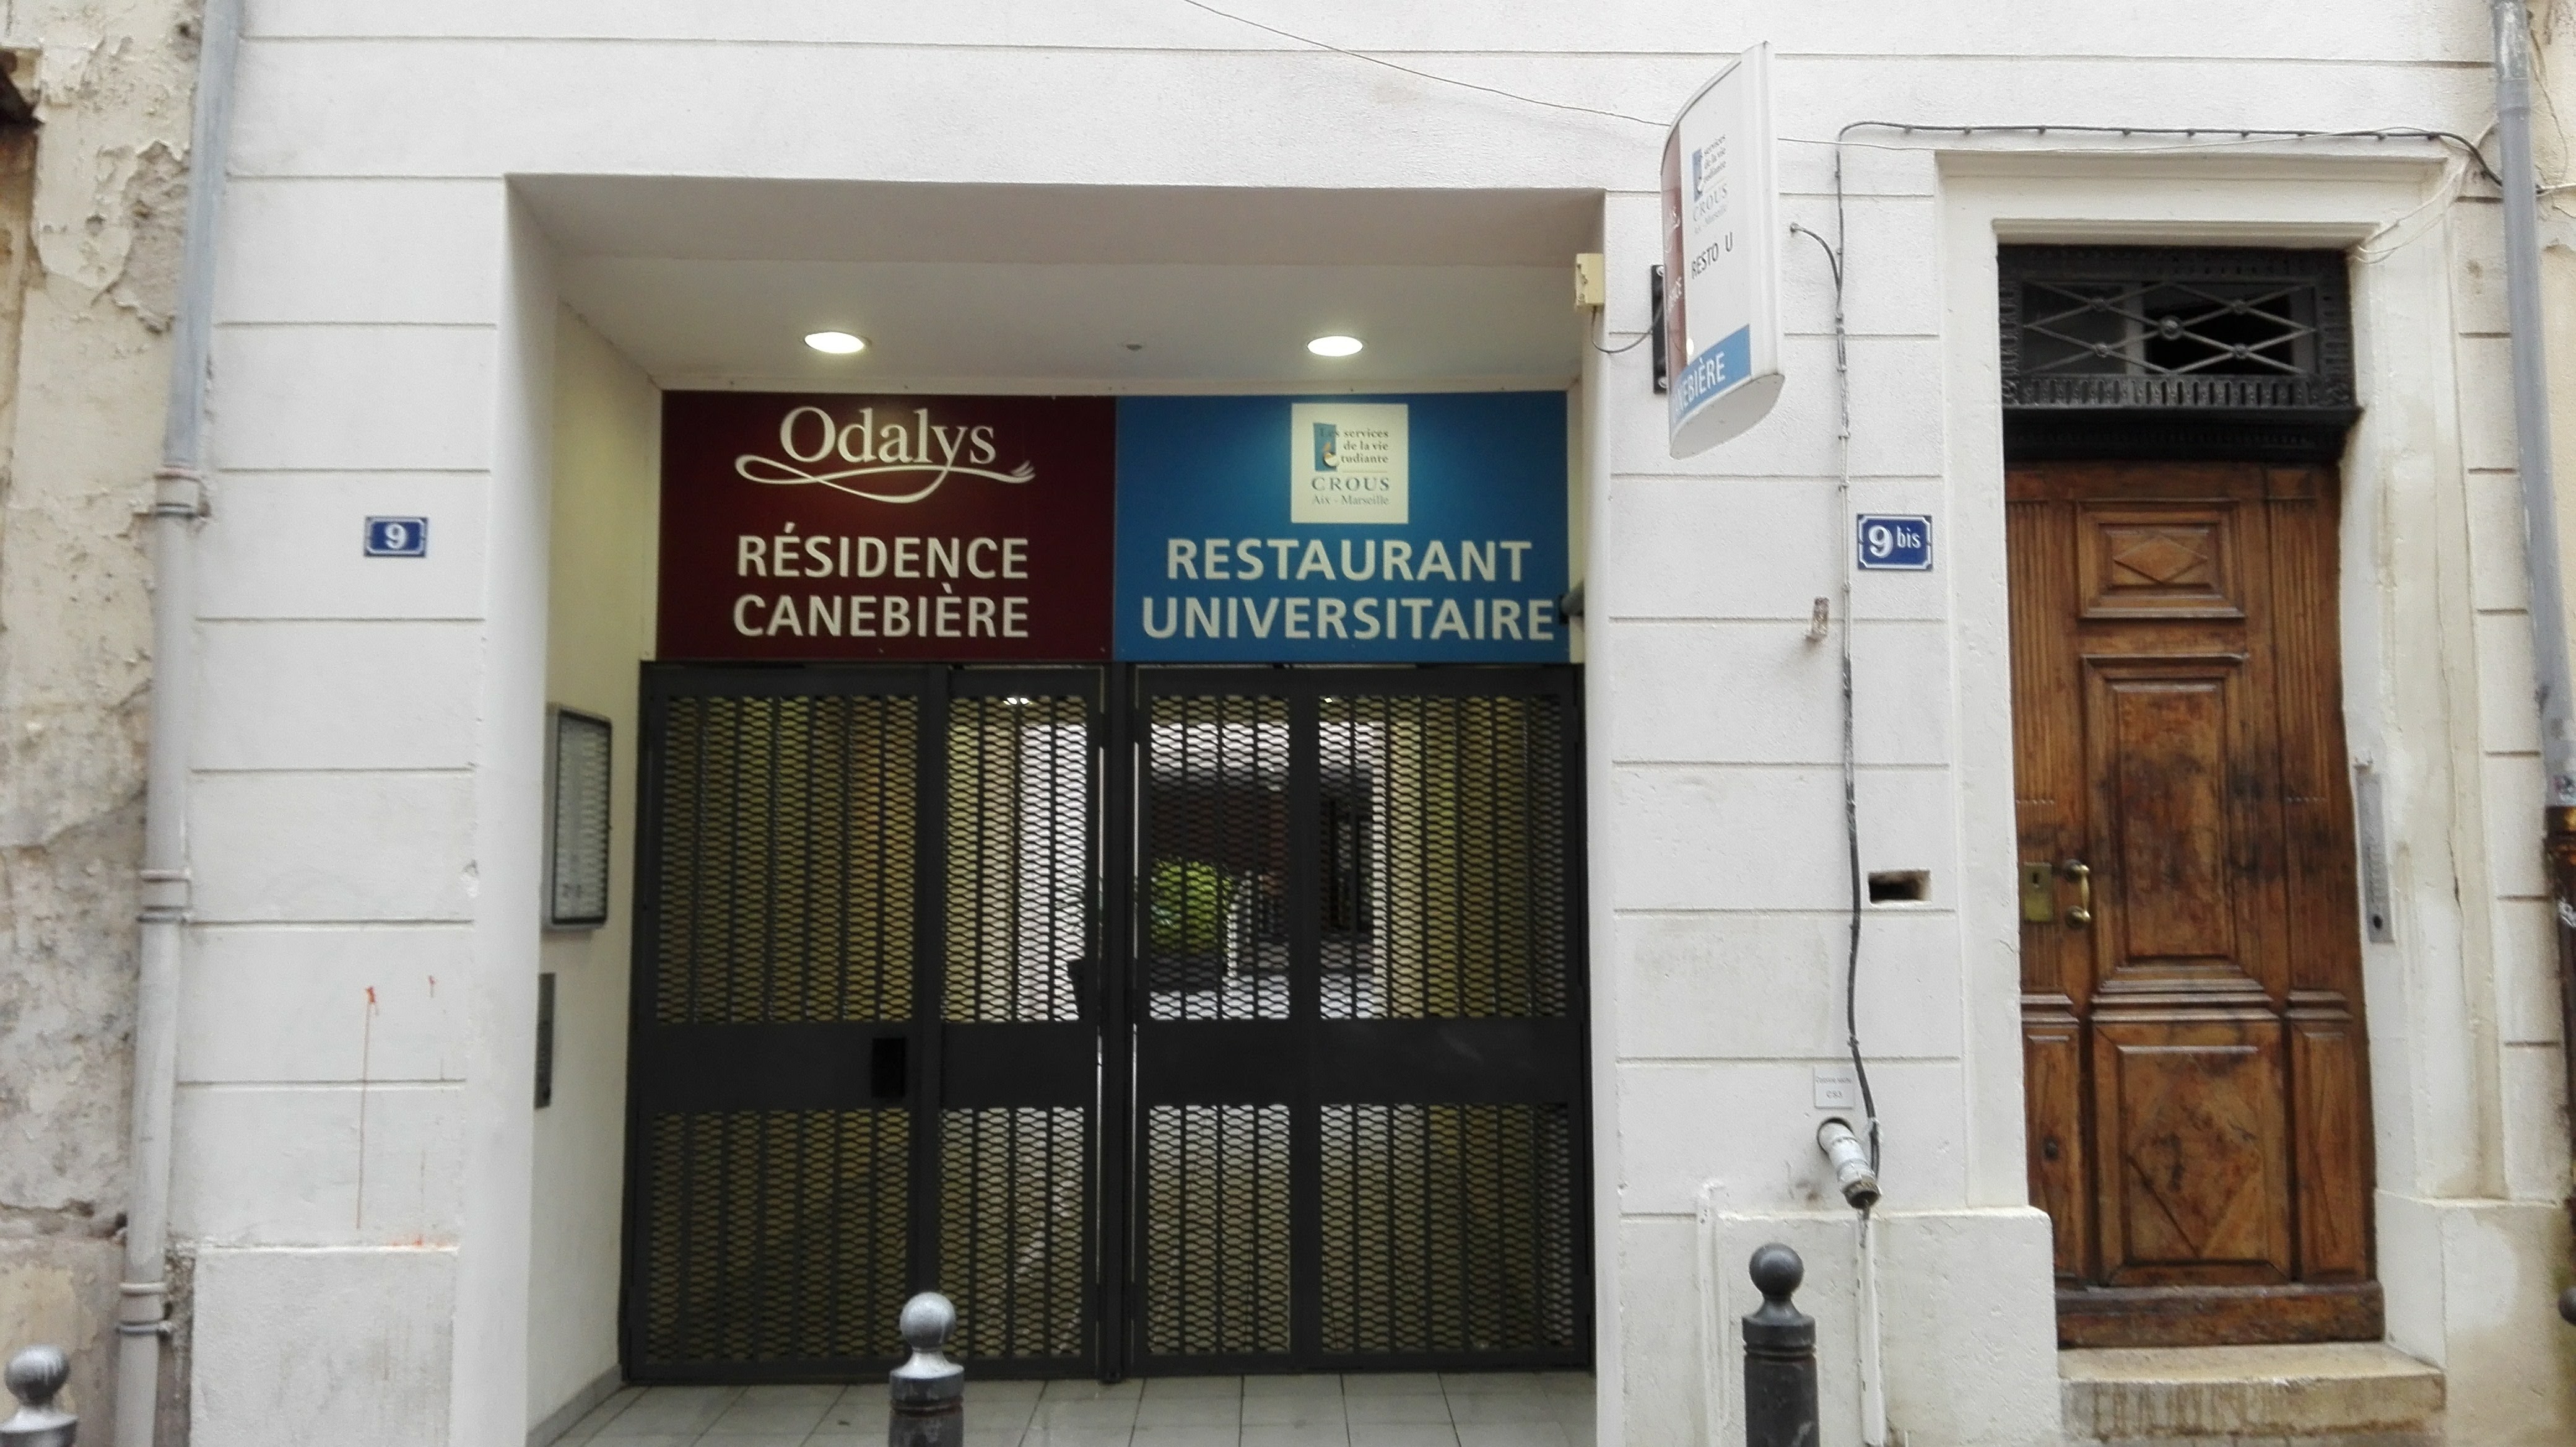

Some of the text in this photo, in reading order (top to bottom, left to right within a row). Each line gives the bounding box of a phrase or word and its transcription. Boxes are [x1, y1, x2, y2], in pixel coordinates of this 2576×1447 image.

[1691, 232, 1733, 280] RESTO U
[1343, 428, 1389, 439] services
[1343, 440, 1389, 451] de la vie
[778, 406, 999, 503] Odalys
[1311, 476, 1390, 491] CROUS
[1312, 494, 1331, 505] Aix
[1341, 494, 1390, 505] Marseille
[385, 523, 407, 549] 9
[737, 522, 1029, 579] RÉSIDENCE
[1868, 525, 1921, 558] 9 bis
[1167, 538, 1532, 581] RESTAURANT
[733, 583, 1029, 637] CANEBIÈRE
[1142, 597, 1554, 640] UNIVERSITAIRE
